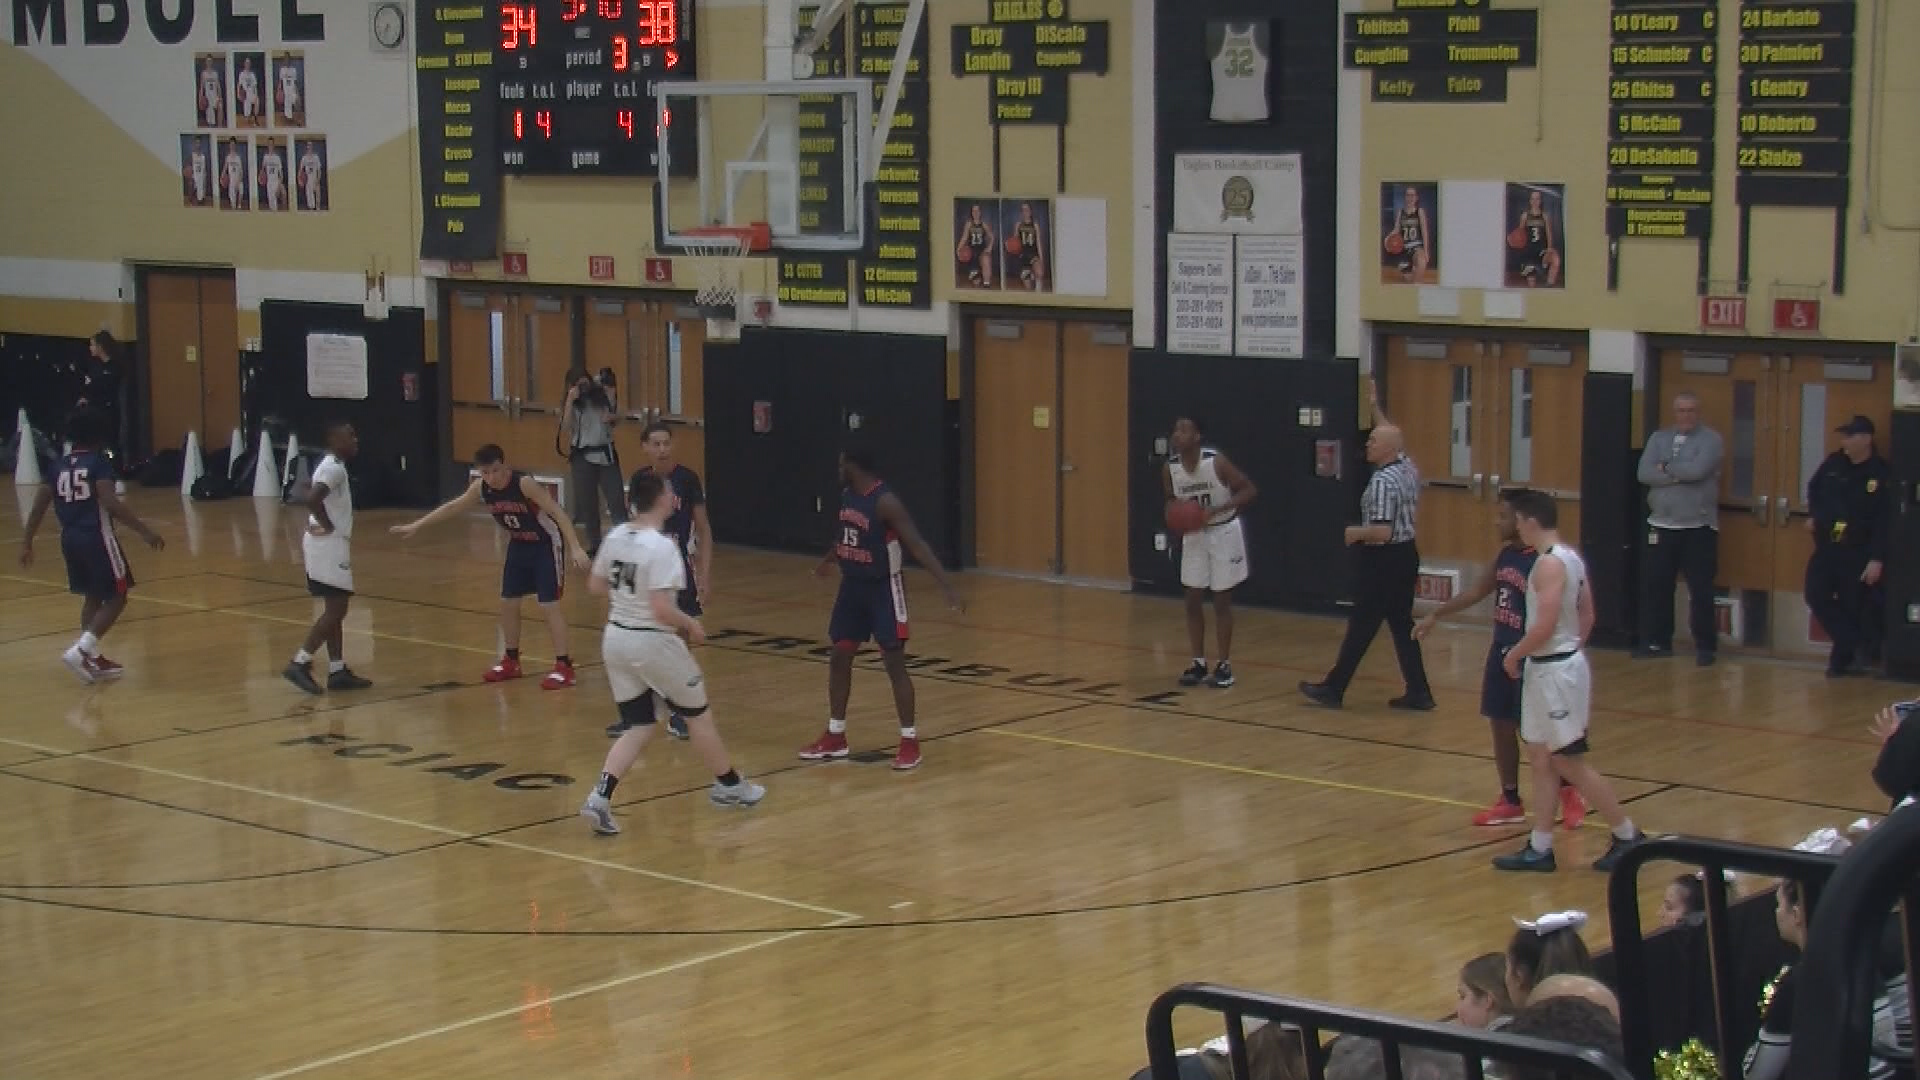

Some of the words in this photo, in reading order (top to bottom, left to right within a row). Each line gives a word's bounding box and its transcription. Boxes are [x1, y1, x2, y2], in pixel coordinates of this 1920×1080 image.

[502, 6, 537, 49] 34
[639, 1, 677, 45] 38
[1613, 15, 1628, 31] 14
[1630, 14, 1679, 31] O'Leary
[1703, 12, 1713, 28] C
[1743, 10, 1760, 27] 24
[971, 28, 1003, 46] Bray
[566, 50, 602, 71] period
[613, 37, 628, 70] 3
[1224, 48, 1255, 78] 32
[1612, 47, 1628, 63] 15
[1702, 46, 1713, 63] C
[566, 80, 602, 101] player
[997, 79, 1026, 98] Bray
[1612, 81, 1629, 98] 25
[1701, 81, 1712, 97] C
[1750, 80, 1758, 97] 1
[536, 111, 551, 140] 4
[617, 111, 632, 140] 4
[1619, 115, 1629, 132] 5
[1741, 115, 1757, 132] 10
[572, 152, 600, 169] game
[1610, 147, 1628, 164] 20
[1740, 148, 1757, 166] 22
[1530, 227, 1539, 242] 3
[593, 259, 612, 277] EXIT
[1710, 301, 1743, 325] EXIT
[57, 468, 92, 501] 45
[842, 526, 859, 547] 15
[608, 559, 638, 595] 34
